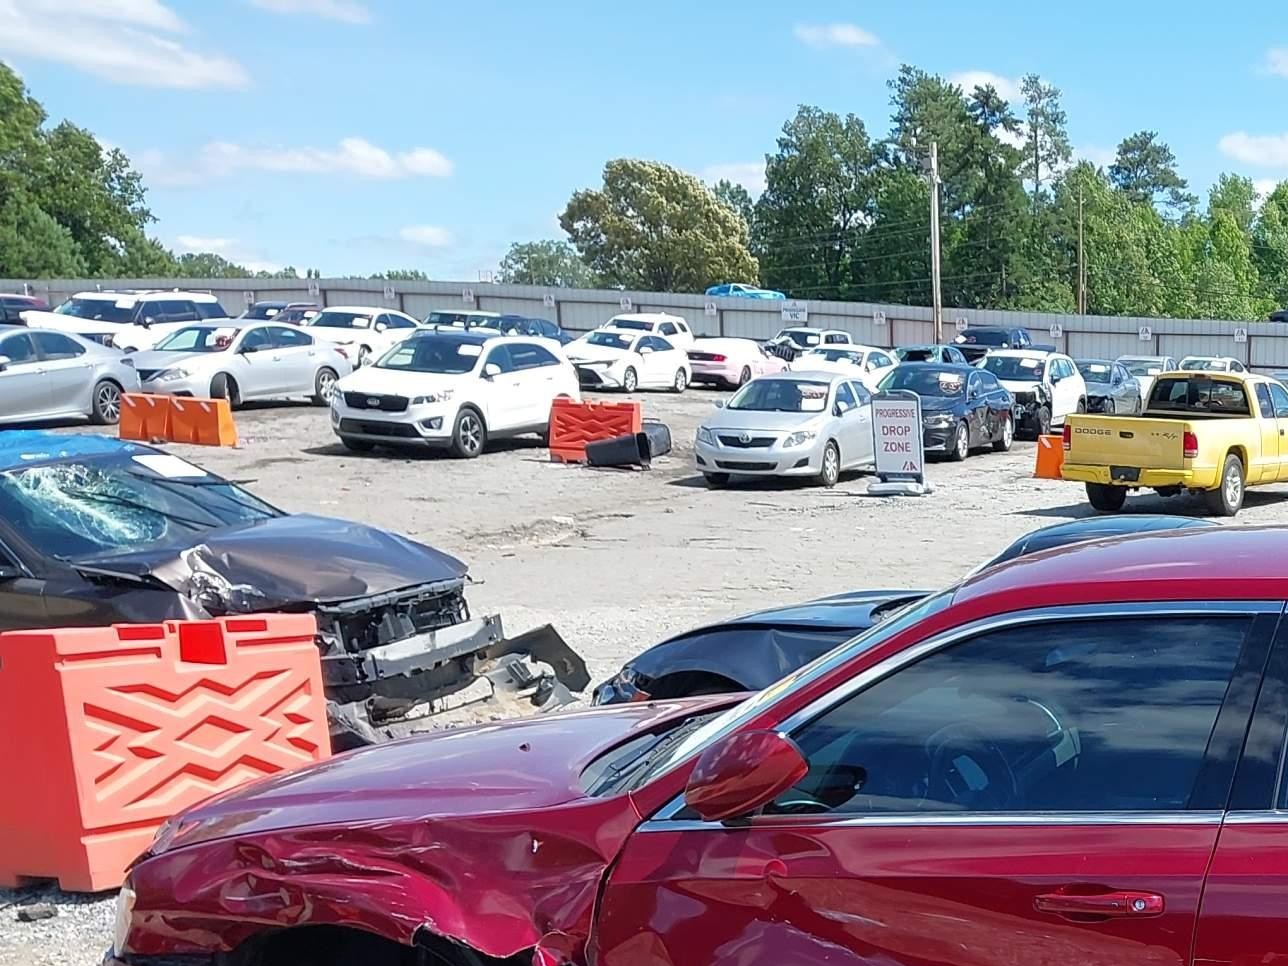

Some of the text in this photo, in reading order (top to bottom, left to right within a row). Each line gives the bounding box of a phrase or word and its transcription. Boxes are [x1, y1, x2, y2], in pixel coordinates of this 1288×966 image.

[875, 408, 916, 418] PROGRESSIVE
[881, 425, 911, 436] DROP
[1074, 427, 1112, 436] DODGE
[883, 441, 912, 453] ZONE
